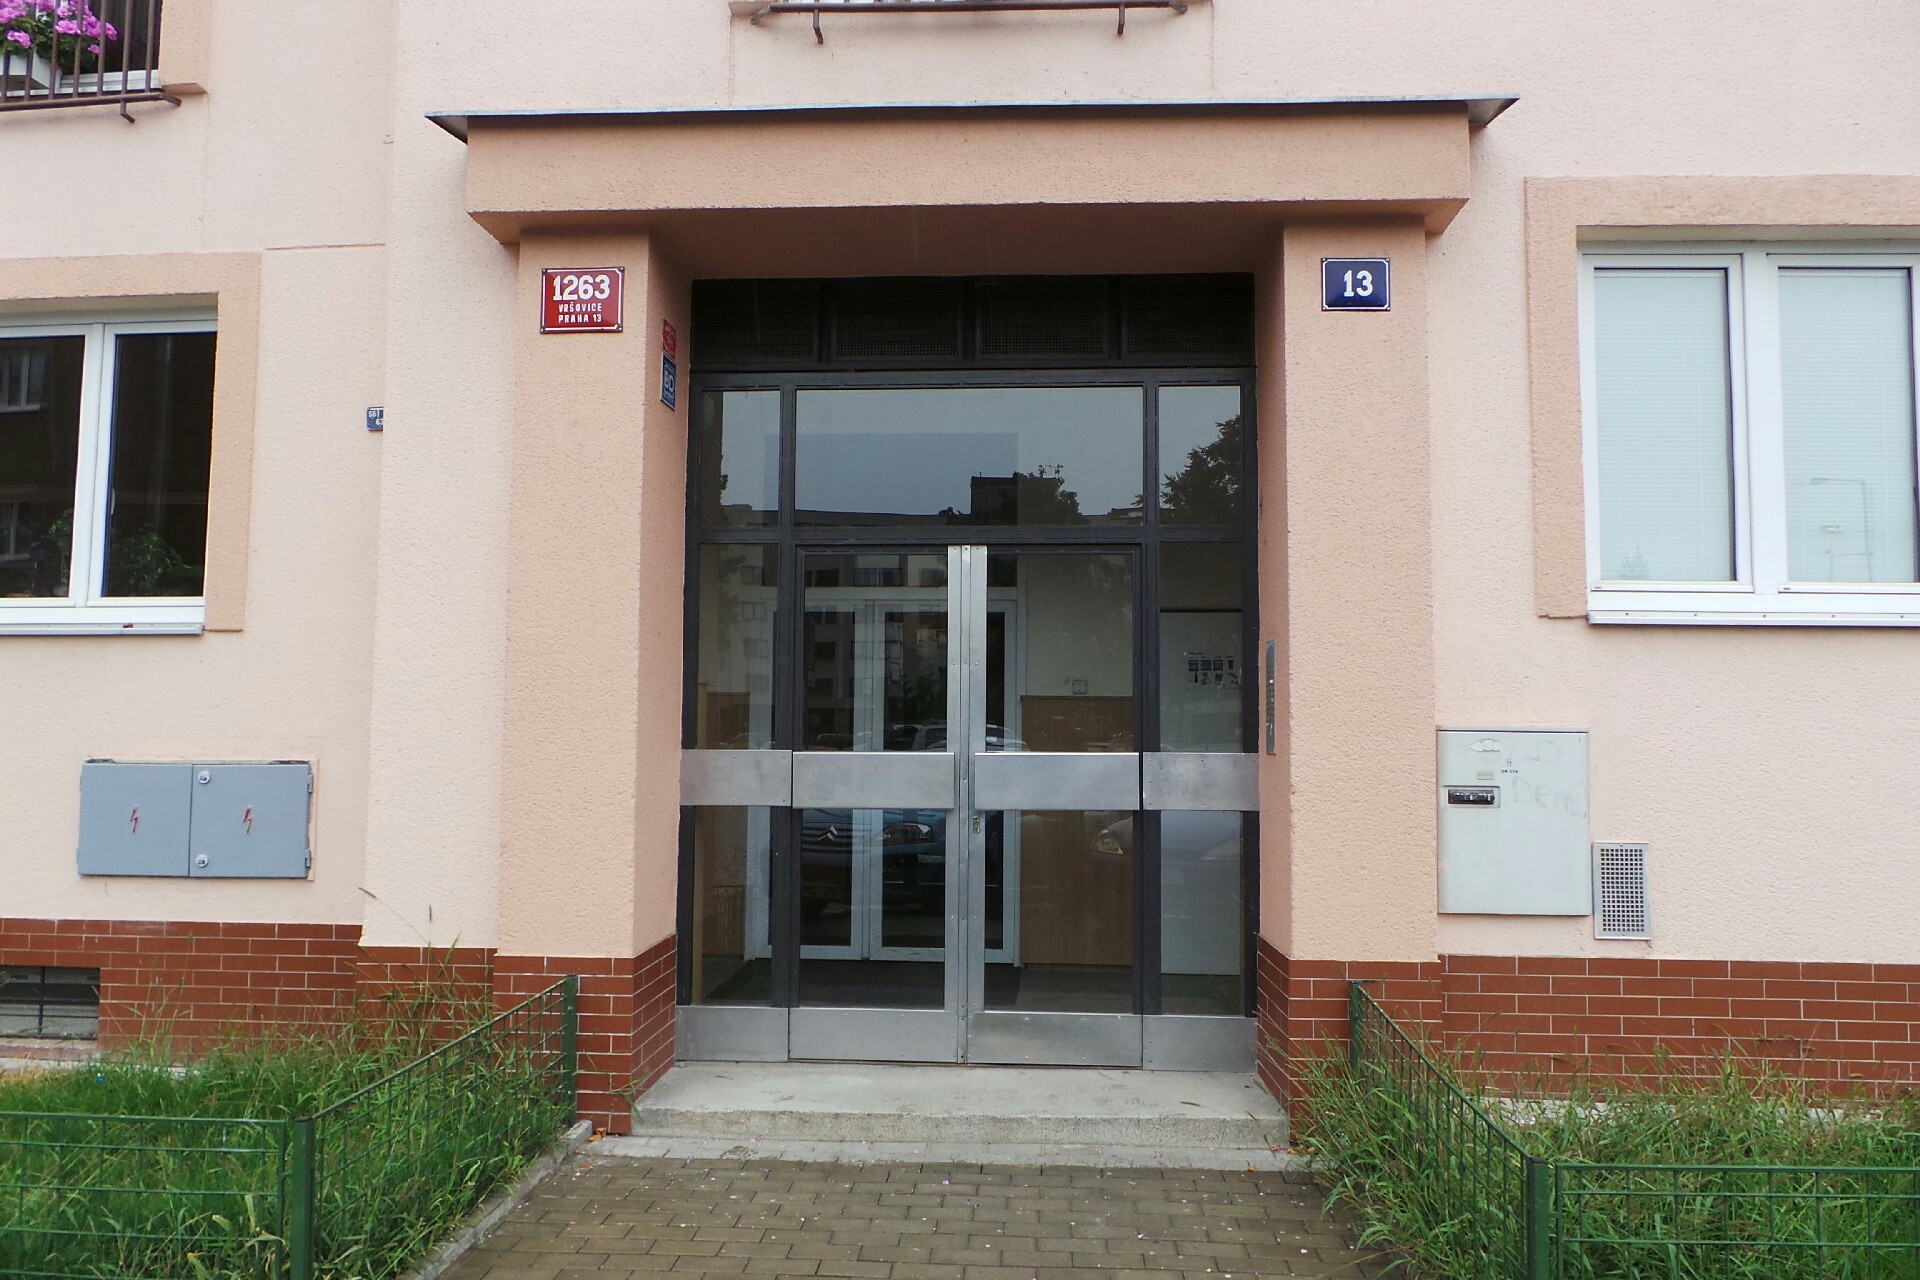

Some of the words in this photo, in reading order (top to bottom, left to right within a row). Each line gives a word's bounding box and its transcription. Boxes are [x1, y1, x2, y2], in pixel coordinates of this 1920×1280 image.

[553, 275, 610, 301] 1263
[1343, 270, 1373, 297] 13
[559, 301, 603, 312] VRŠOVICE
[558, 314, 589, 324] PRAHA
[592, 313, 602, 322] 13
